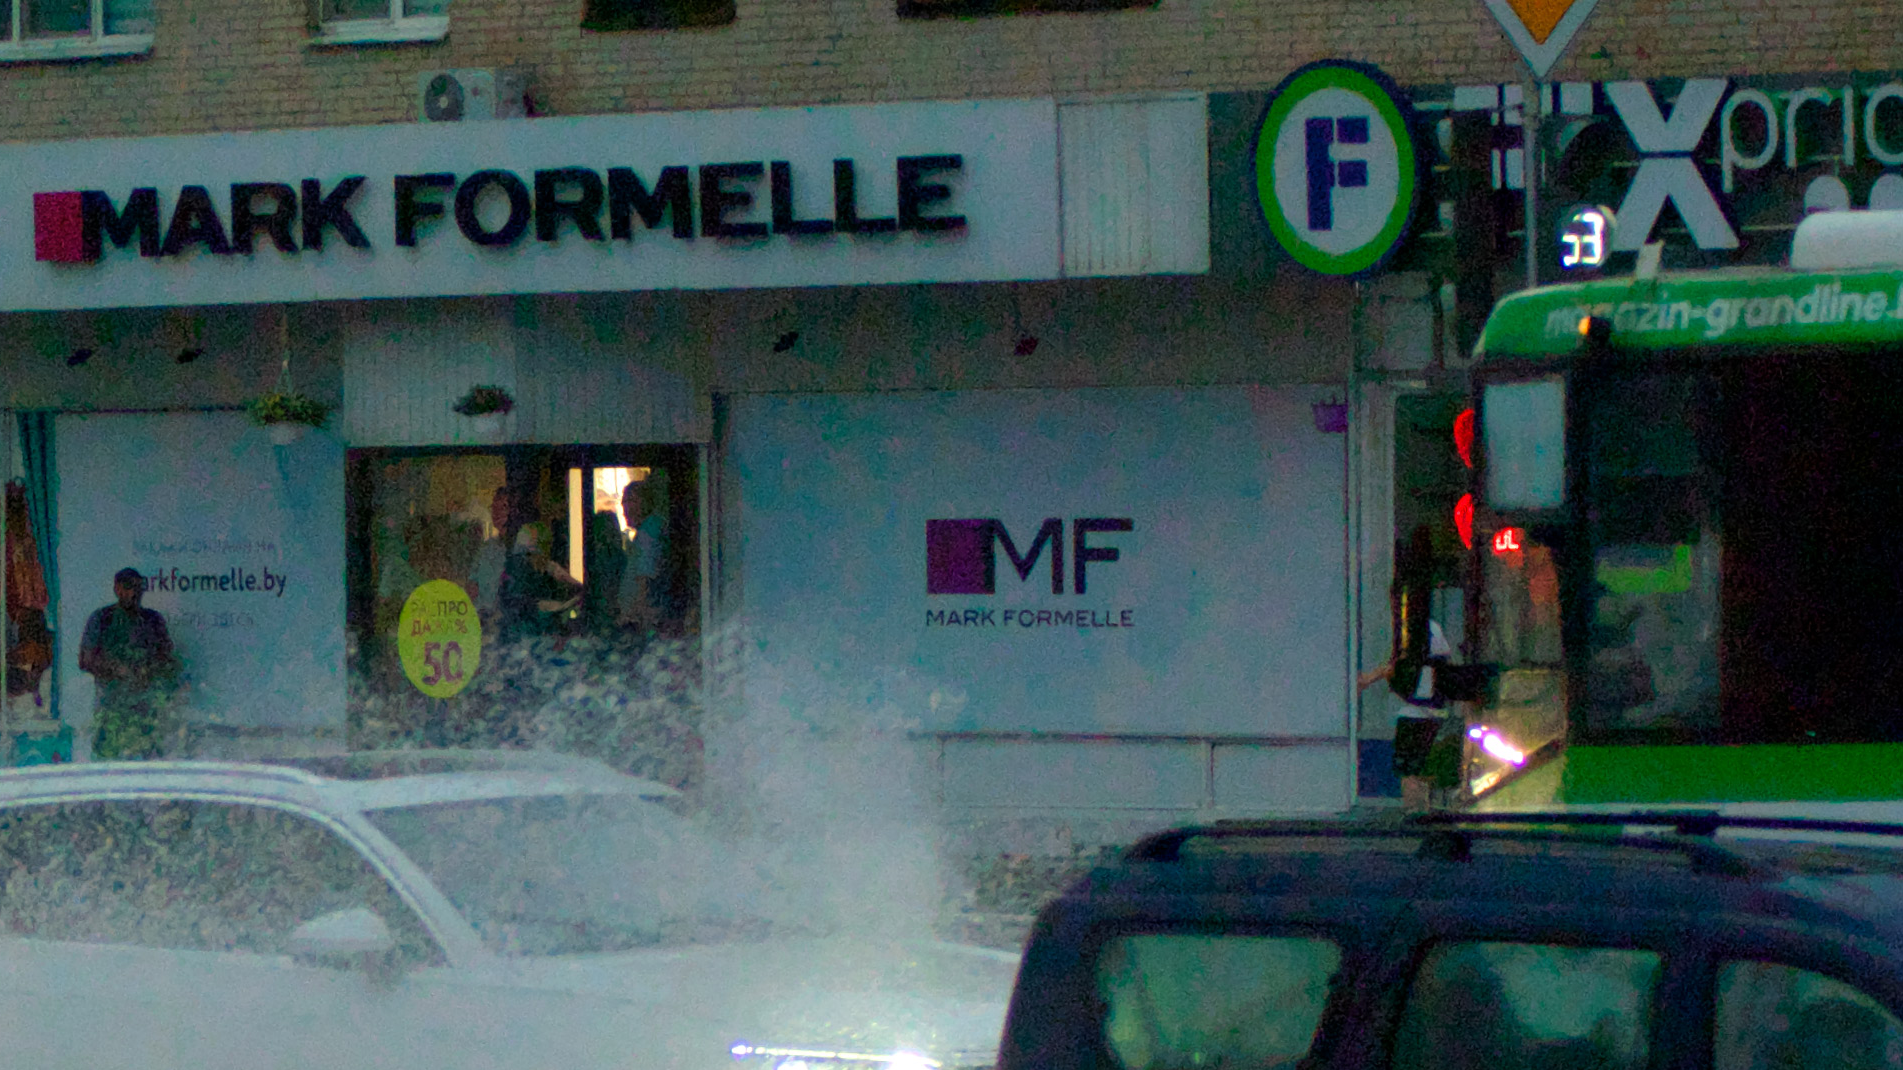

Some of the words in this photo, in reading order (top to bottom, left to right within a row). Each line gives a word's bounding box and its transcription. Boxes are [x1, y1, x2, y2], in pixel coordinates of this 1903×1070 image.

[1305, 116, 1370, 232] F
[81, 175, 371, 264] MARK
[394, 154, 967, 250] FORMELLE
[140, 566, 287, 598] arkformelle.by
[982, 517, 1134, 595] MF
[925, 609, 995, 627] MARK
[1003, 609, 1136, 628] FORMELLE
[422, 640, 464, 686] 50
